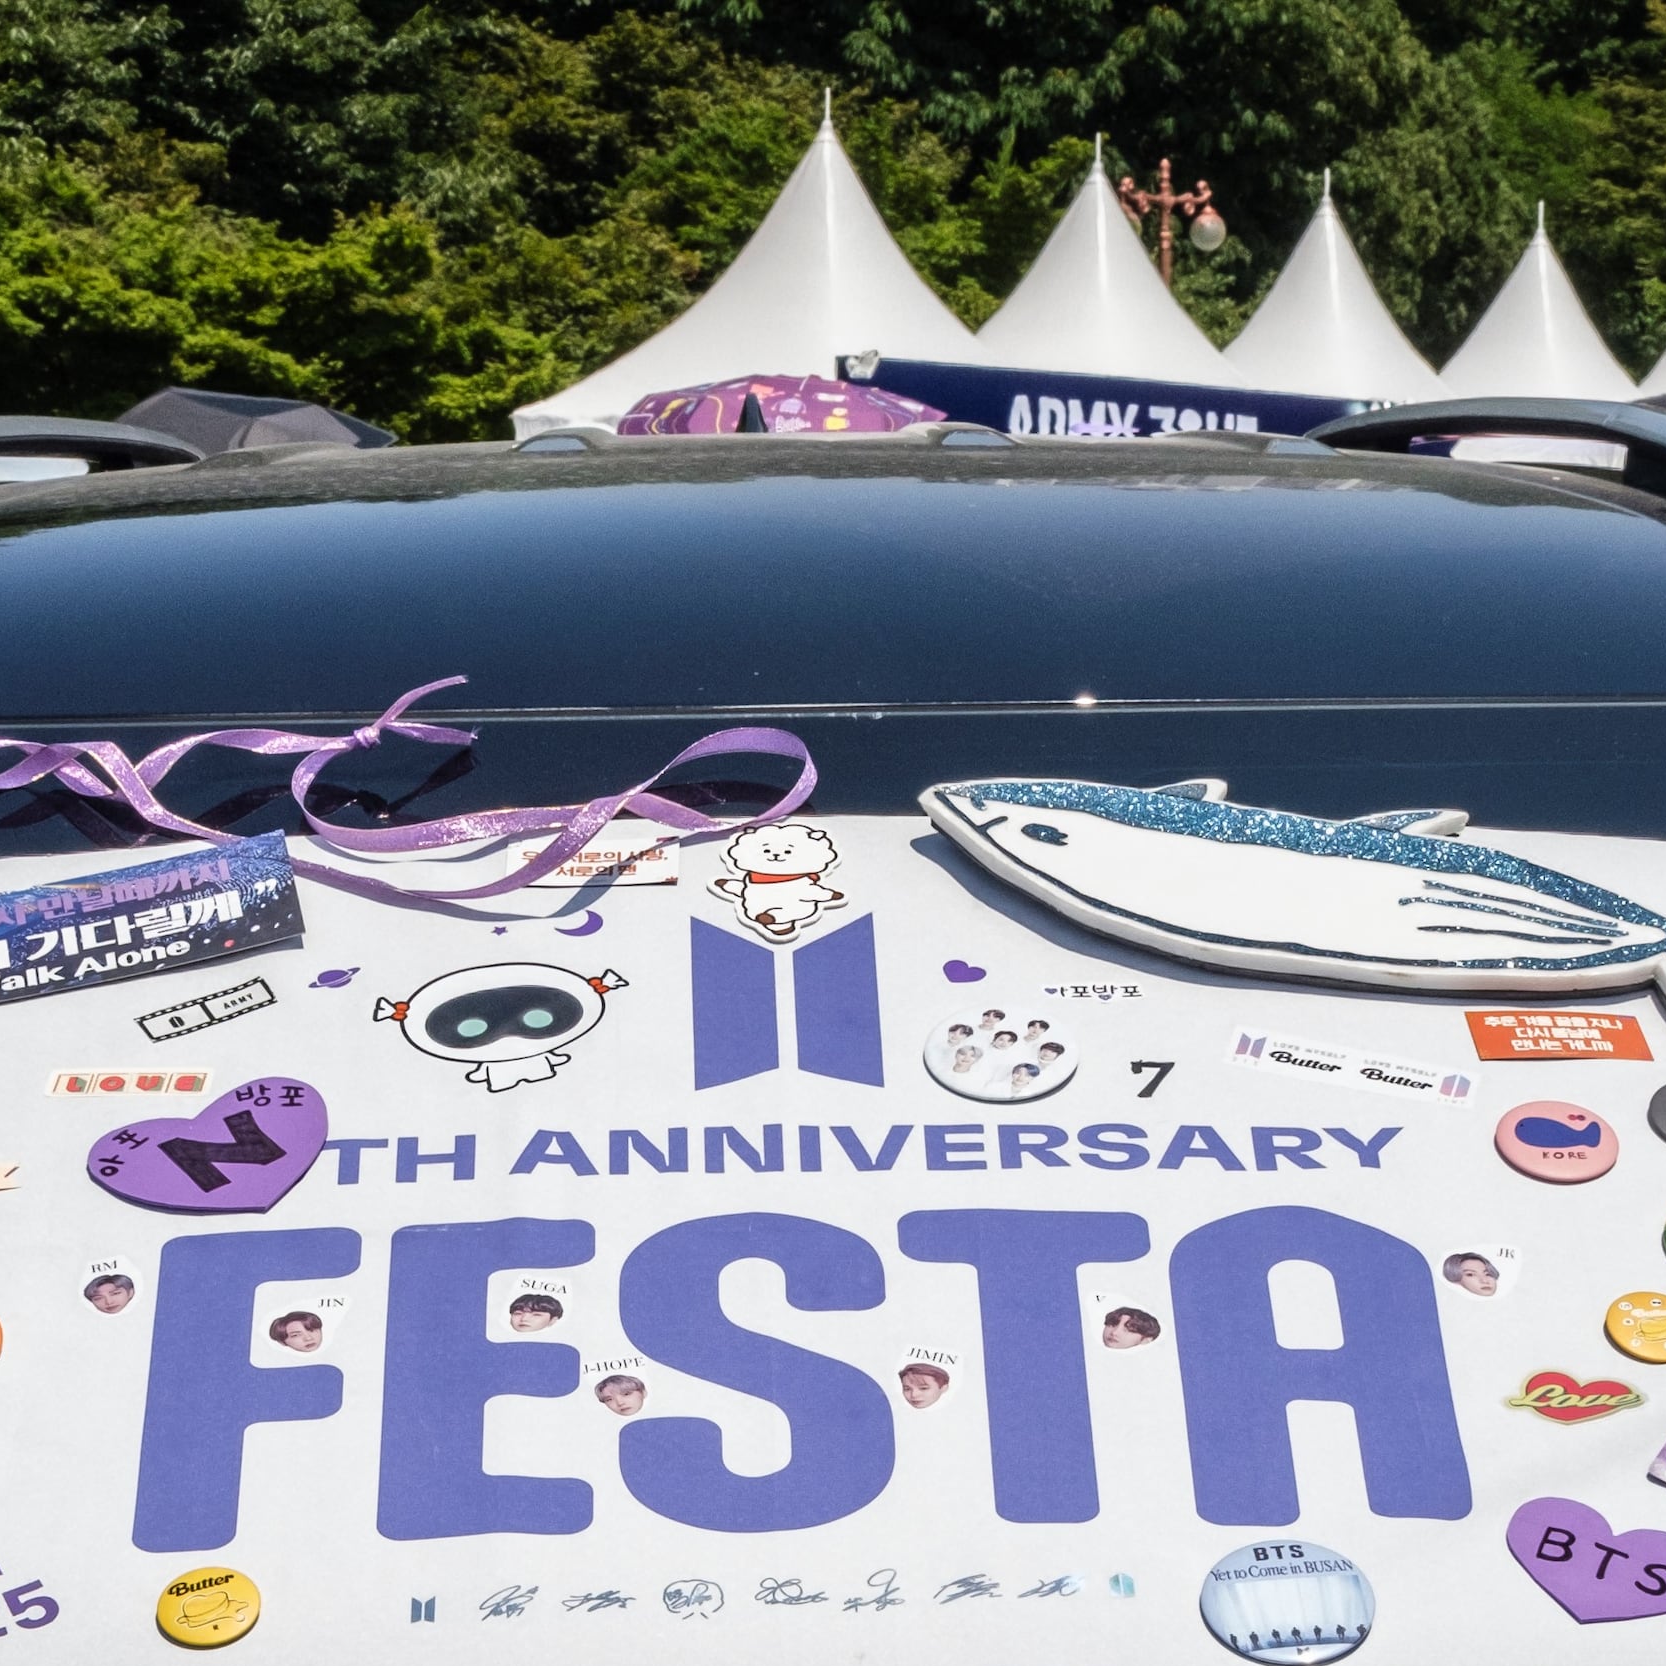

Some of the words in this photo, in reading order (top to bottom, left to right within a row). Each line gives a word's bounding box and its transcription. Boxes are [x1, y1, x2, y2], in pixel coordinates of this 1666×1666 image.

[1009, 394, 1139, 436] ARMY
[74, 939, 191, 978] Alone
[224, 992, 253, 1010] ARMY
[1514, 1027, 1550, 1039] 다시
[1269, 1050, 1342, 1073] Butter
[65, 1075, 204, 1093] LOVE
[1130, 1060, 1175, 1098] 7
[1360, 1067, 1433, 1090] Butter
[157, 1109, 288, 1193] N
[324, 1135, 477, 1185] TH
[509, 1123, 1405, 1175] ANNIVERSARY
[1542, 1151, 1588, 1160] KORE
[1496, 1247, 1515, 1259] JK
[91, 1260, 118, 1273] RM
[520, 1279, 568, 1294] SUGA
[318, 1297, 345, 1308] JIN
[906, 1346, 958, 1364] JIMIN
[583, 1357, 646, 1375] J-HOPE
[132, 1205, 1474, 1553] FESTA
[1509, 1384, 1641, 1407] Love
[1252, 1544, 1305, 1562] BTS
[1210, 1568, 1232, 1582] Yet
[1233, 1568, 1248, 1580] to
[1248, 1564, 1288, 1578] Come
[1290, 1563, 1303, 1574] in
[1303, 1559, 1354, 1575] BUSAN
[167, 1574, 235, 1597] Butter
